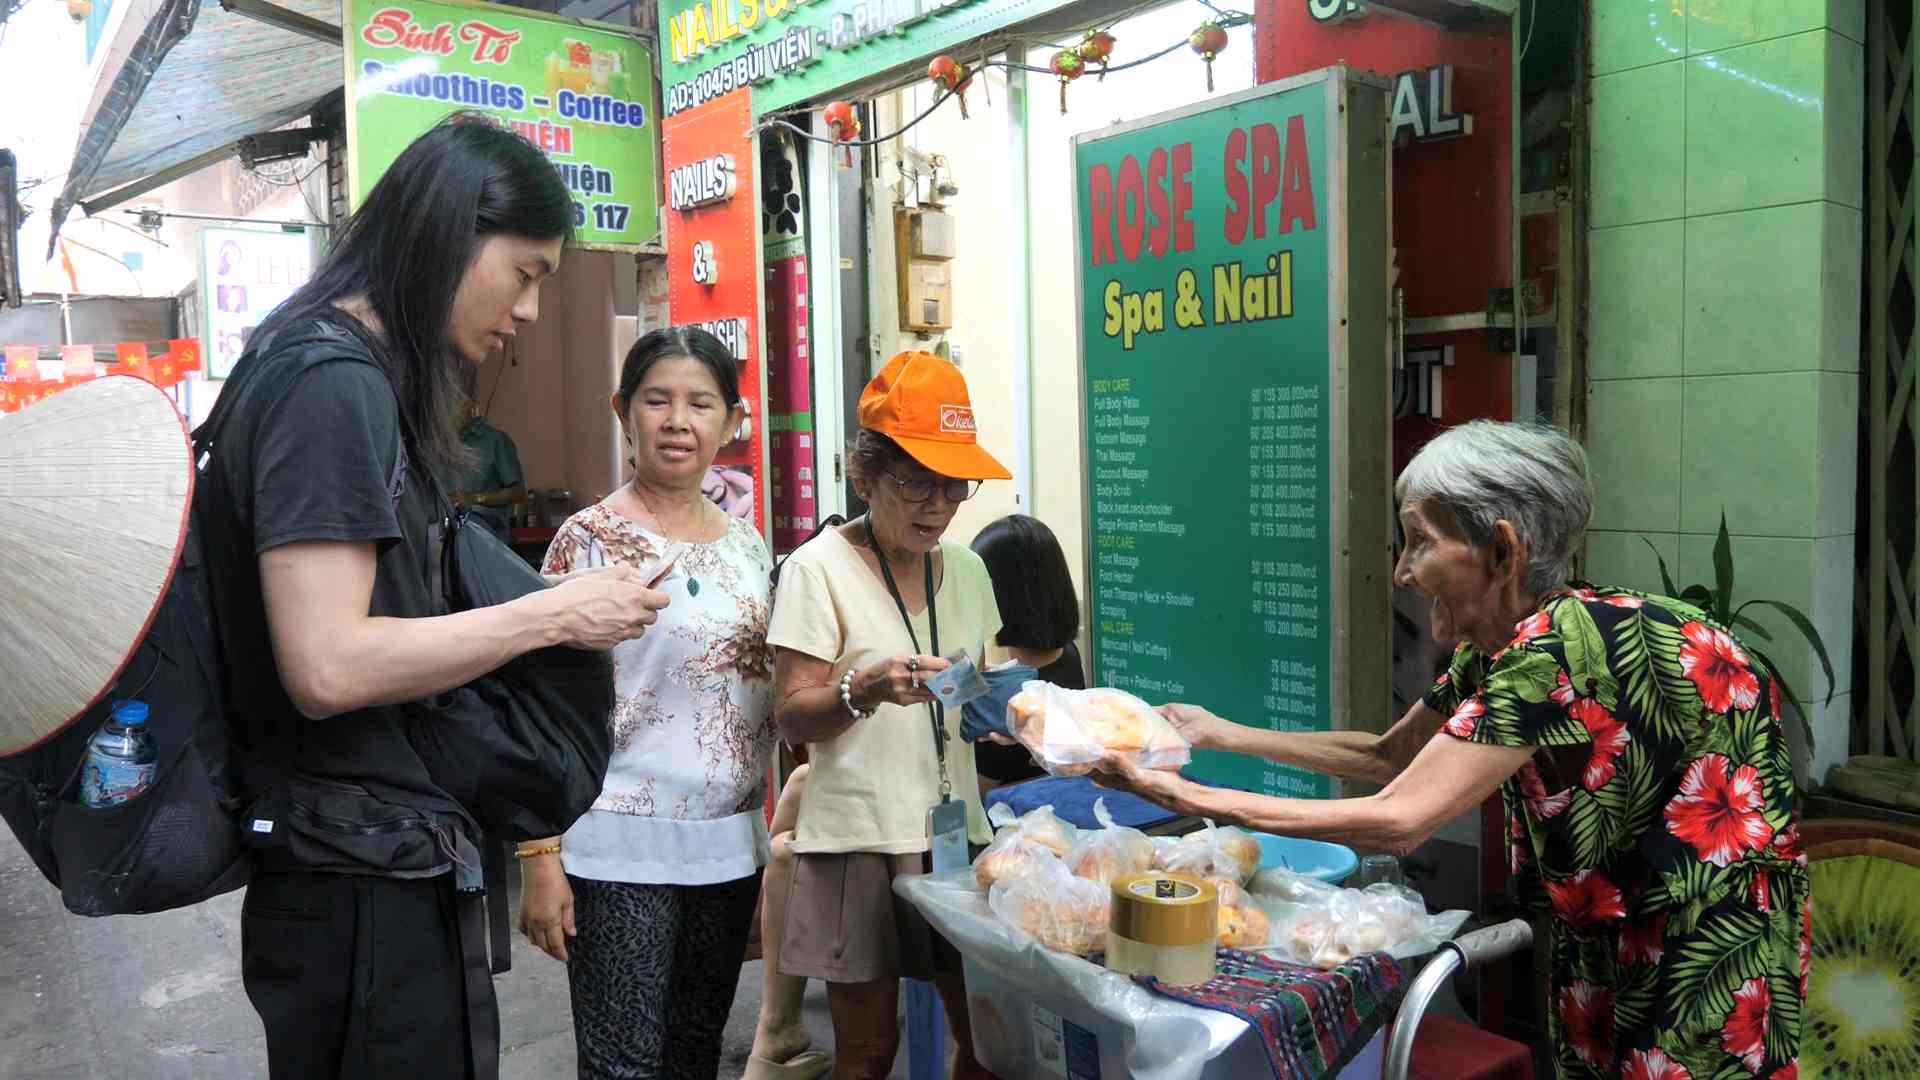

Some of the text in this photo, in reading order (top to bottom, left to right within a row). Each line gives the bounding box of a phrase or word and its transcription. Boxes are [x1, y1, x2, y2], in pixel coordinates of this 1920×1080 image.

[362, 9, 454, 55] Sinh
[697, 61, 734, 103] 104/5
[737, 44, 766, 88] BÙI
[769, 29, 812, 71] VIỆN
[558, 91, 643, 126] Coffee
[670, 156, 727, 210] NAILS
[1088, 114, 1317, 267] ROSE SPA
[593, 204, 629, 230] 117
[693, 242, 708, 283] &
[1104, 249, 1293, 351] Spa & Nail
